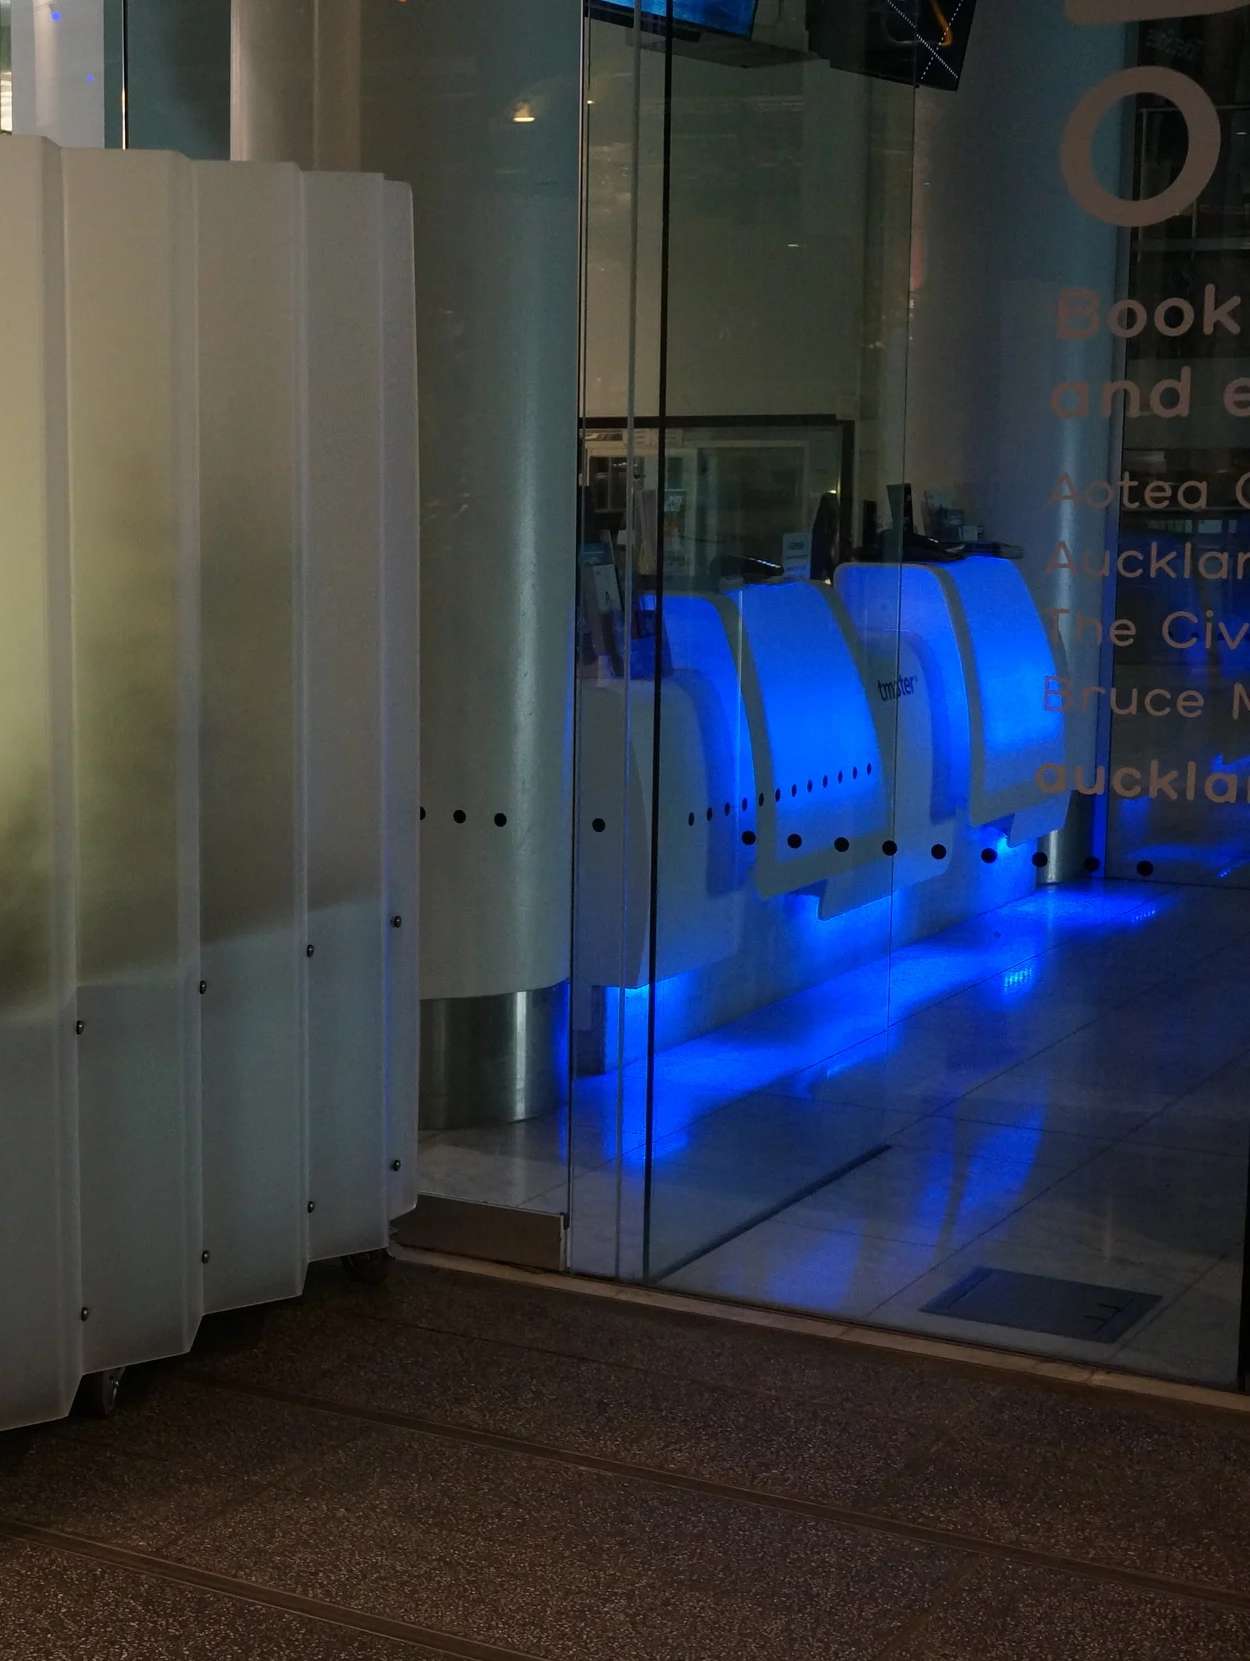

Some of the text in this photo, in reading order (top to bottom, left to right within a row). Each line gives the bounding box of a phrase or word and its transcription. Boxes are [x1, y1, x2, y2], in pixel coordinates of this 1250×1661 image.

[1056, 283, 1241, 339] Book
[1051, 365, 1191, 419] and
[1047, 471, 1208, 510] Aotea
[1041, 608, 1249, 650] The Civ
[1043, 675, 1205, 718] Bruce
[1035, 758, 1250, 804] auckla
